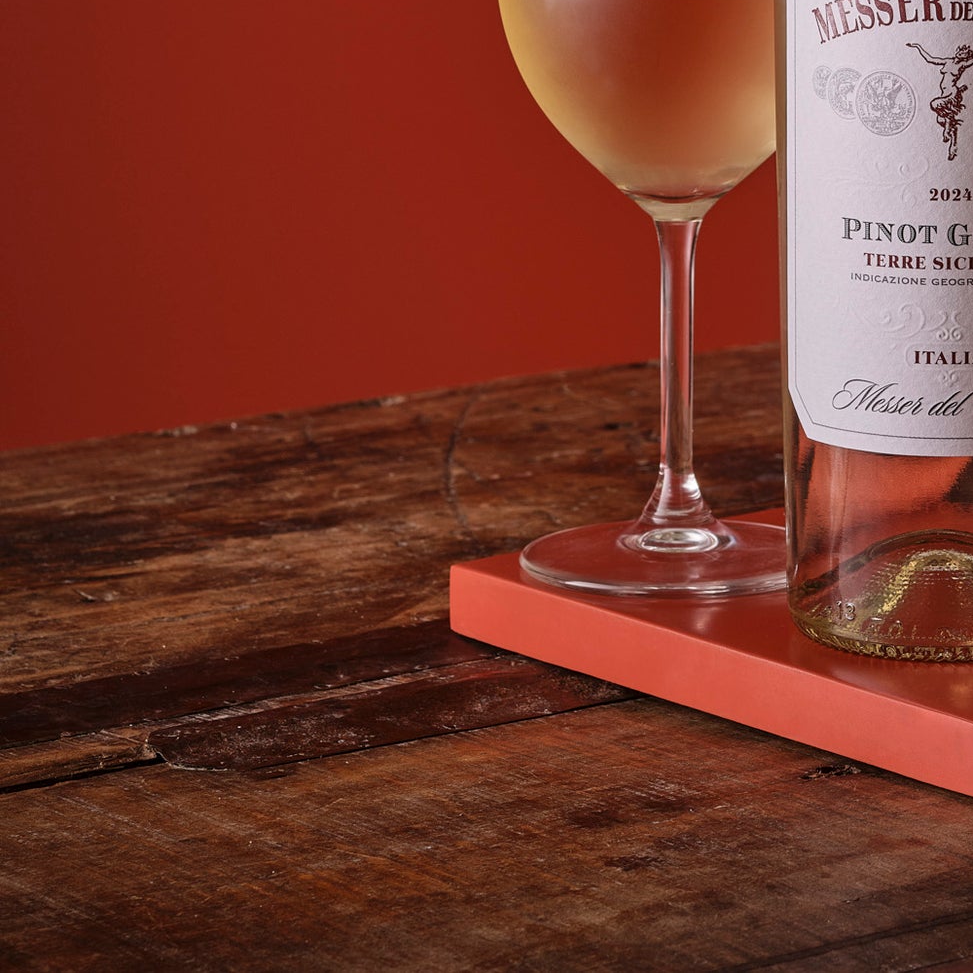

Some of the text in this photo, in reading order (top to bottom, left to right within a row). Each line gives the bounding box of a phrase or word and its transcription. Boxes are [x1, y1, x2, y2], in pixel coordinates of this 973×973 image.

[929, 188, 973, 202] 2024
[841, 217, 938, 245] PINOT
[863, 252, 926, 270] TERRE
[849, 272, 927, 286] INDICAZIONE
[832, 379, 924, 416] Messer
